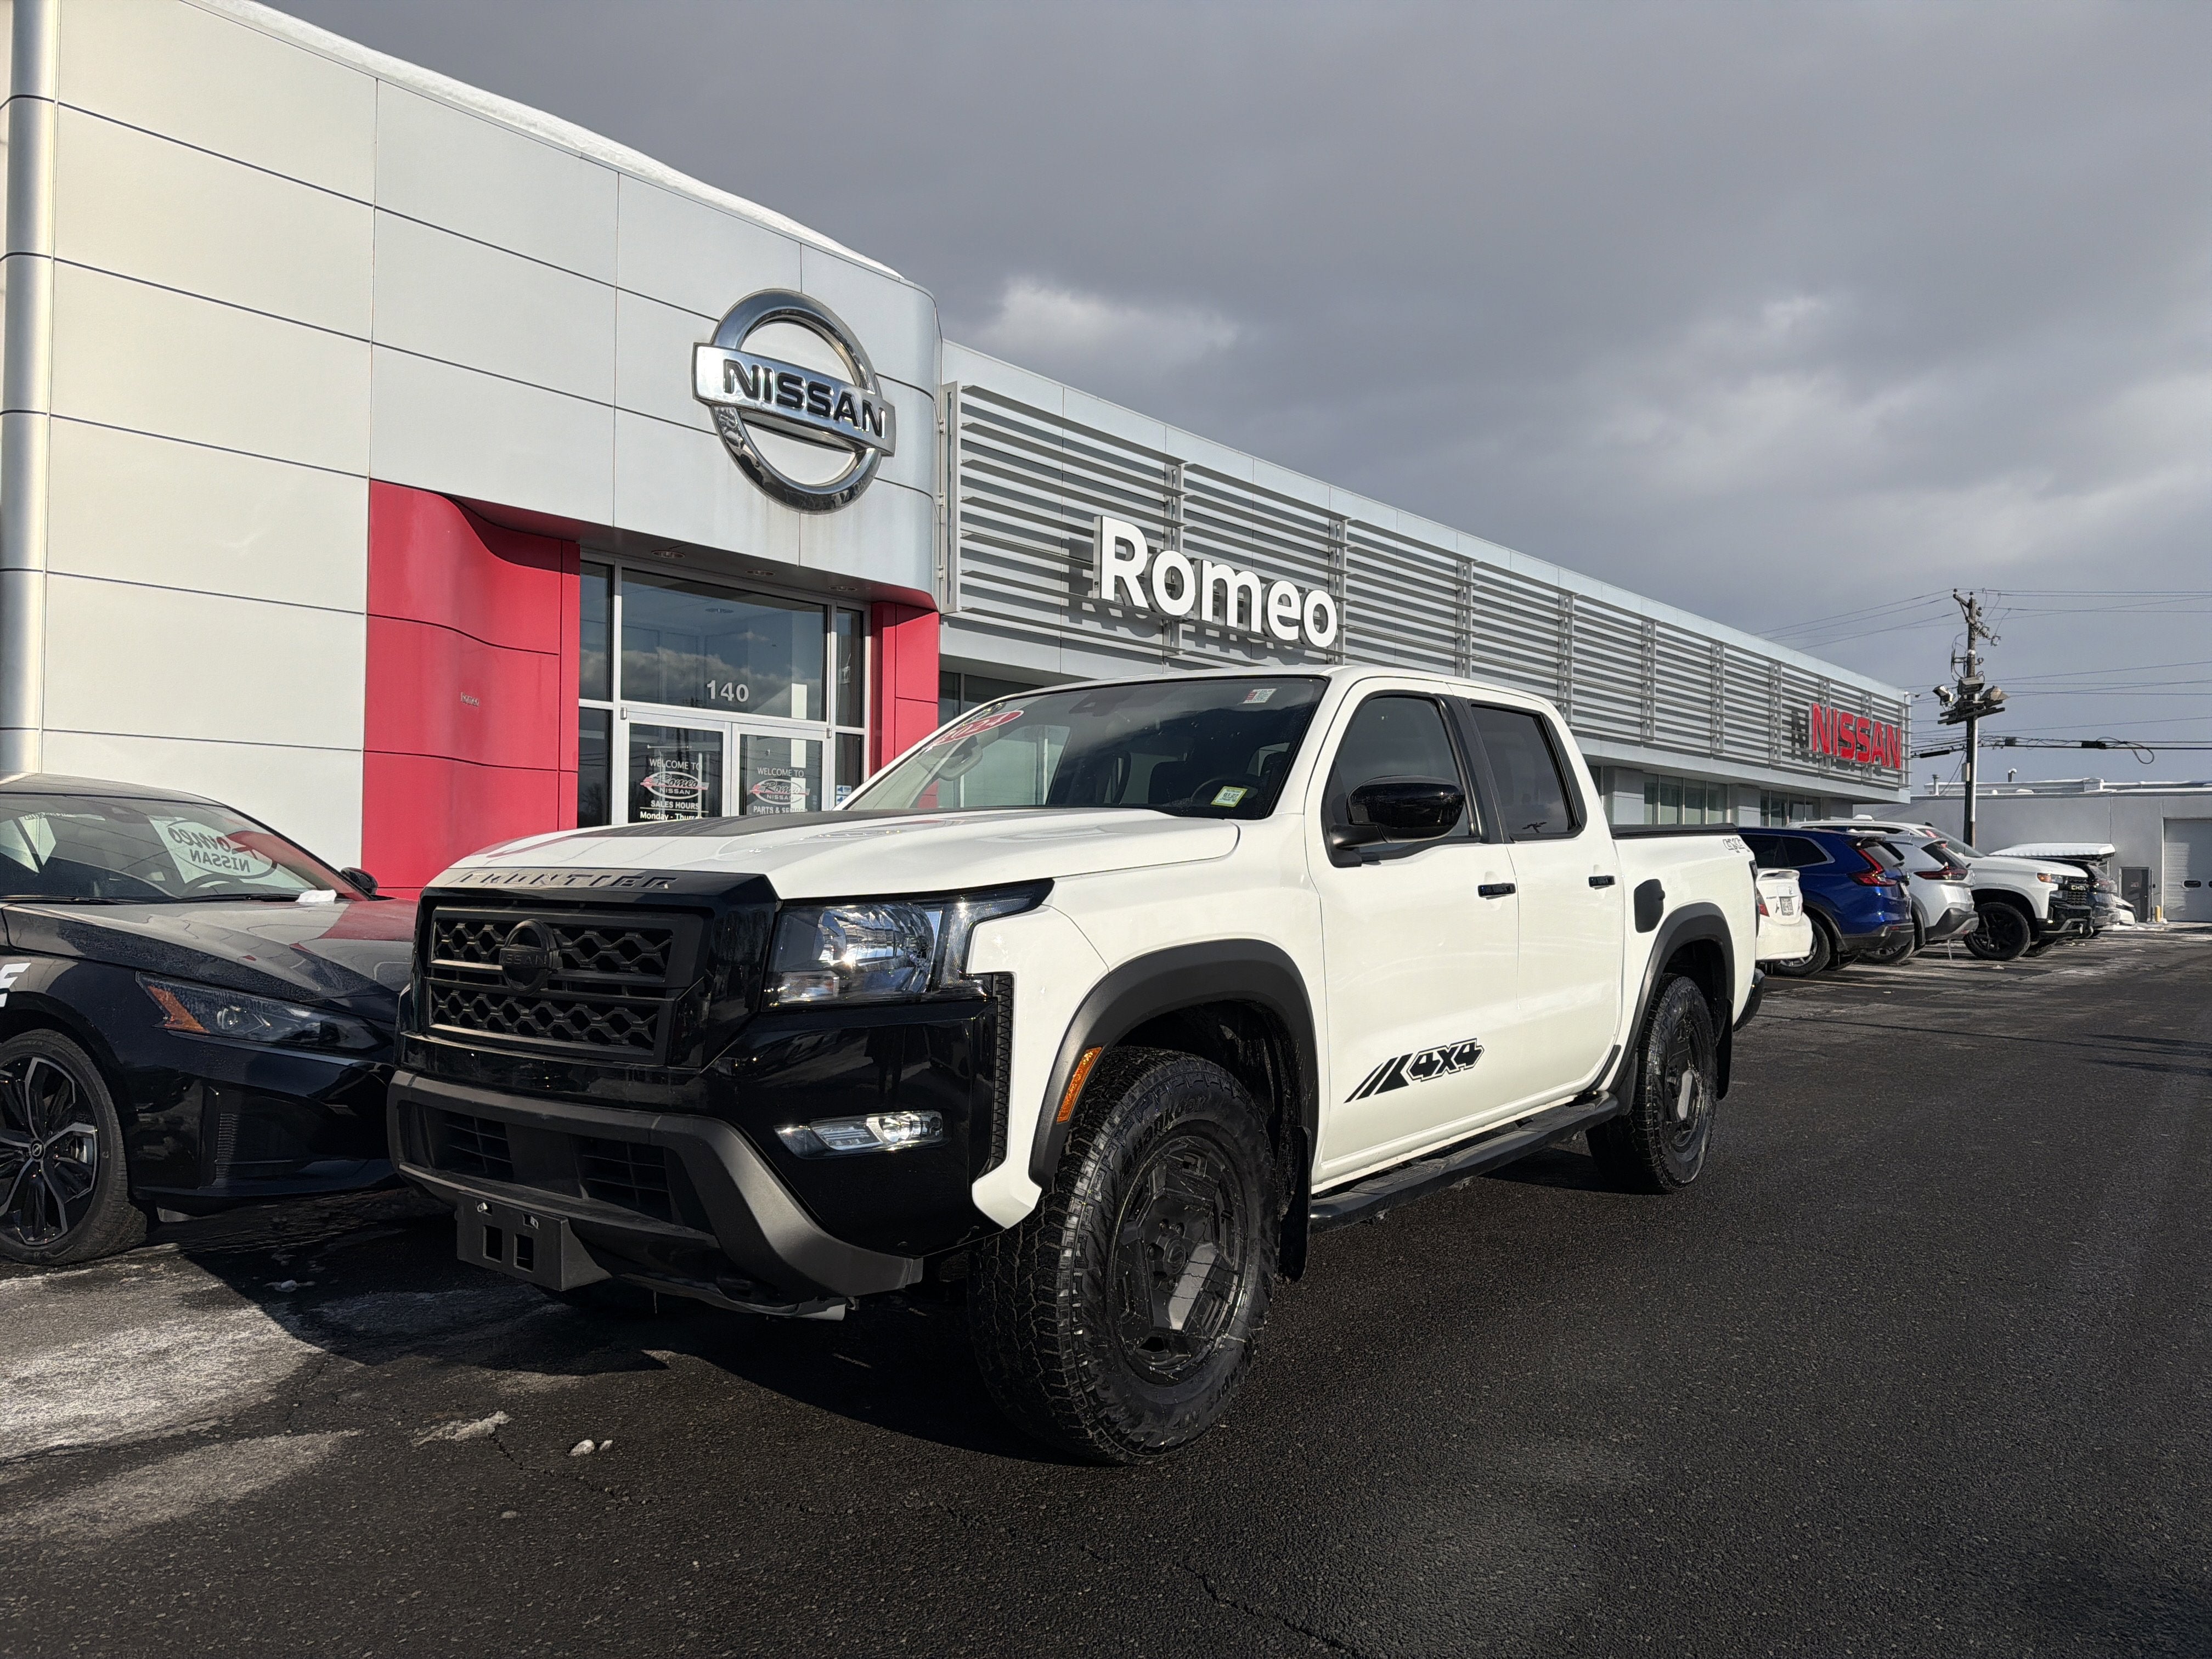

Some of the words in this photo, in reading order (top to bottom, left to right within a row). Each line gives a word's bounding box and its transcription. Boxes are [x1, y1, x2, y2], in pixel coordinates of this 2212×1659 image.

[723, 358, 886, 439] NISSAN
[1095, 515, 1338, 648] Romeo
[707, 680, 749, 702] 140
[1811, 703, 1901, 769] NISSAN
[649, 758, 689, 770] WELCOME
[691, 762, 702, 771] TO
[757, 767, 792, 776] WELCOME
[657, 772, 698, 788] Romeo
[651, 800, 673, 808] SALES
[675, 801, 699, 810] HOURS
[753, 805, 774, 814] PARTS
[640, 811, 669, 821] Monday
[460, 873, 678, 889] FRONTIER
[500, 952, 547, 966] SSAN
[1408, 1040, 1483, 1081] 4X4
